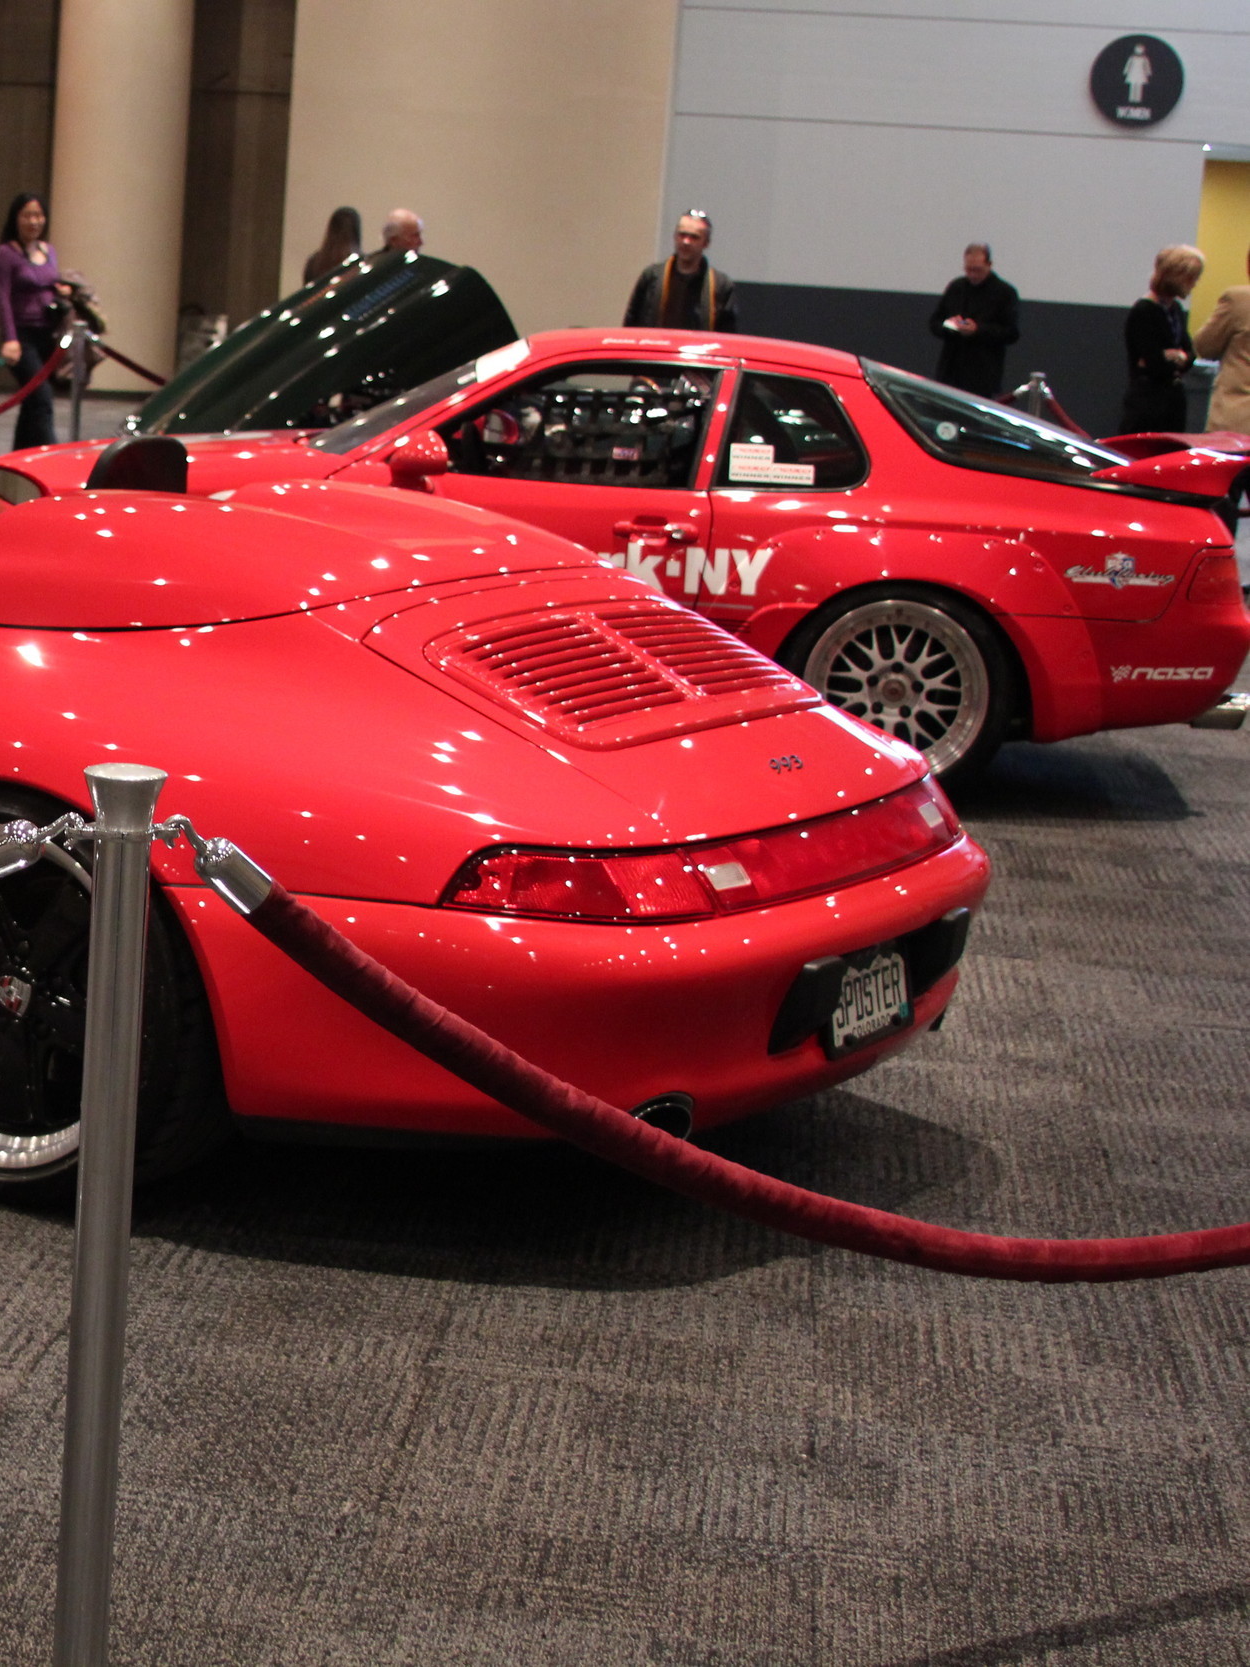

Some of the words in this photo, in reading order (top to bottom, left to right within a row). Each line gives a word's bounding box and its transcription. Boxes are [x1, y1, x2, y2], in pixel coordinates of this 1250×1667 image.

[1116, 106, 1152, 119] WOMEN
[769, 754, 803, 774] 993
[851, 1013, 891, 1037] COLORADO
